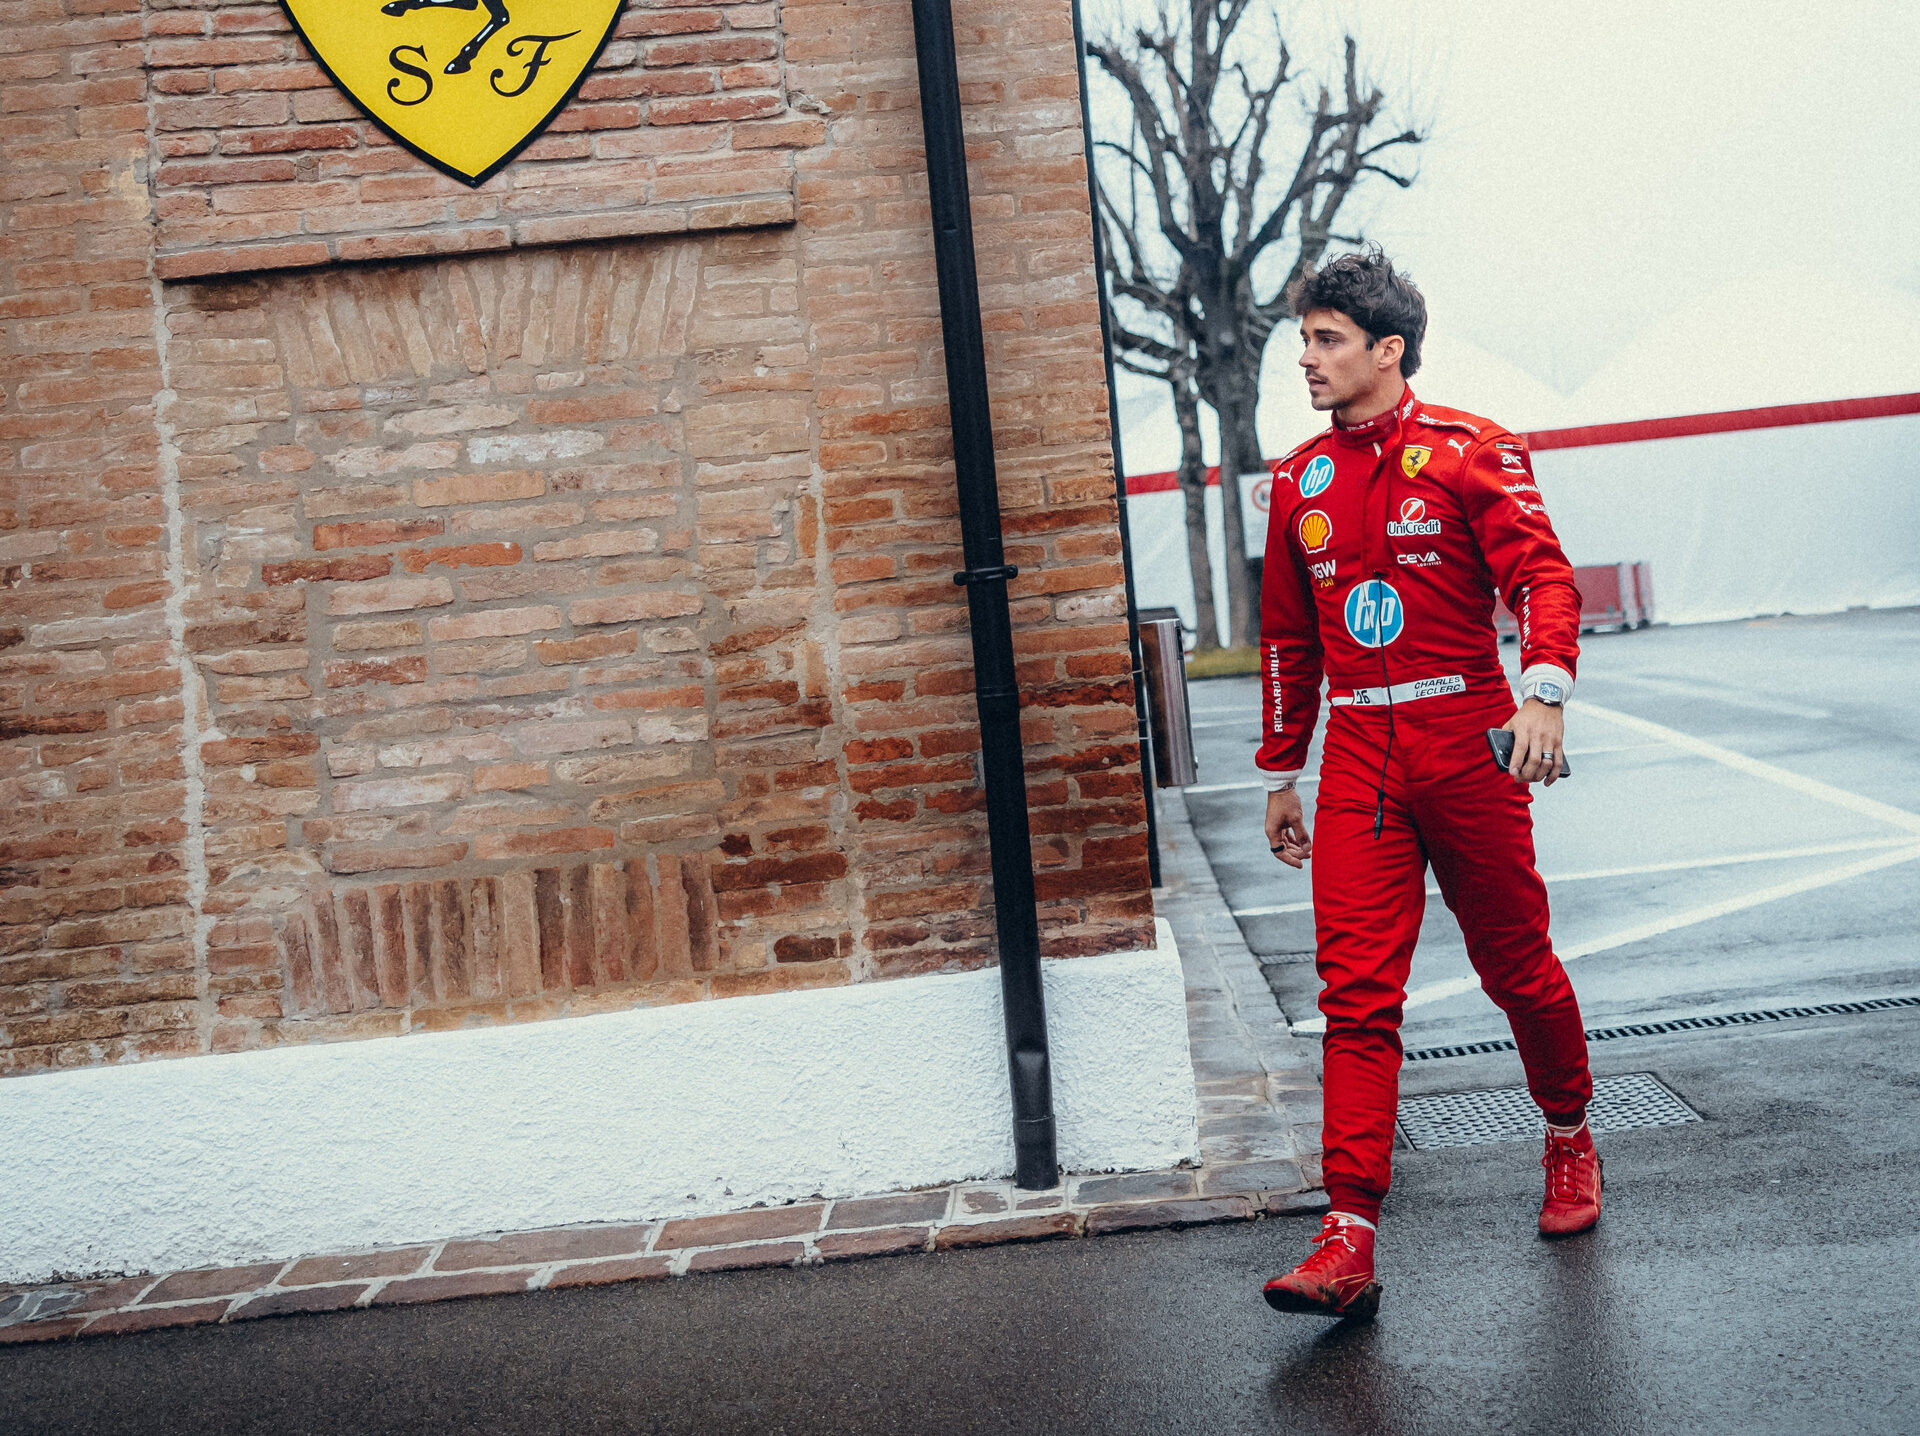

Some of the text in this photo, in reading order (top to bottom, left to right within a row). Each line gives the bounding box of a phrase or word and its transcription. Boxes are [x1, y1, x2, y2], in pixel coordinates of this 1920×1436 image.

[387, 29, 582, 106] S F
[1304, 456, 1331, 496] hp
[1388, 520, 1440, 535] UniCredit
[1397, 551, 1440, 564] CEVA
[1354, 581, 1396, 647] hp
[1270, 644, 1283, 733] RICHARD MILLE
[1414, 676, 1461, 690] CHARLES
[1356, 690, 1371, 704] 16
[1415, 684, 1461, 698] LECLERC
